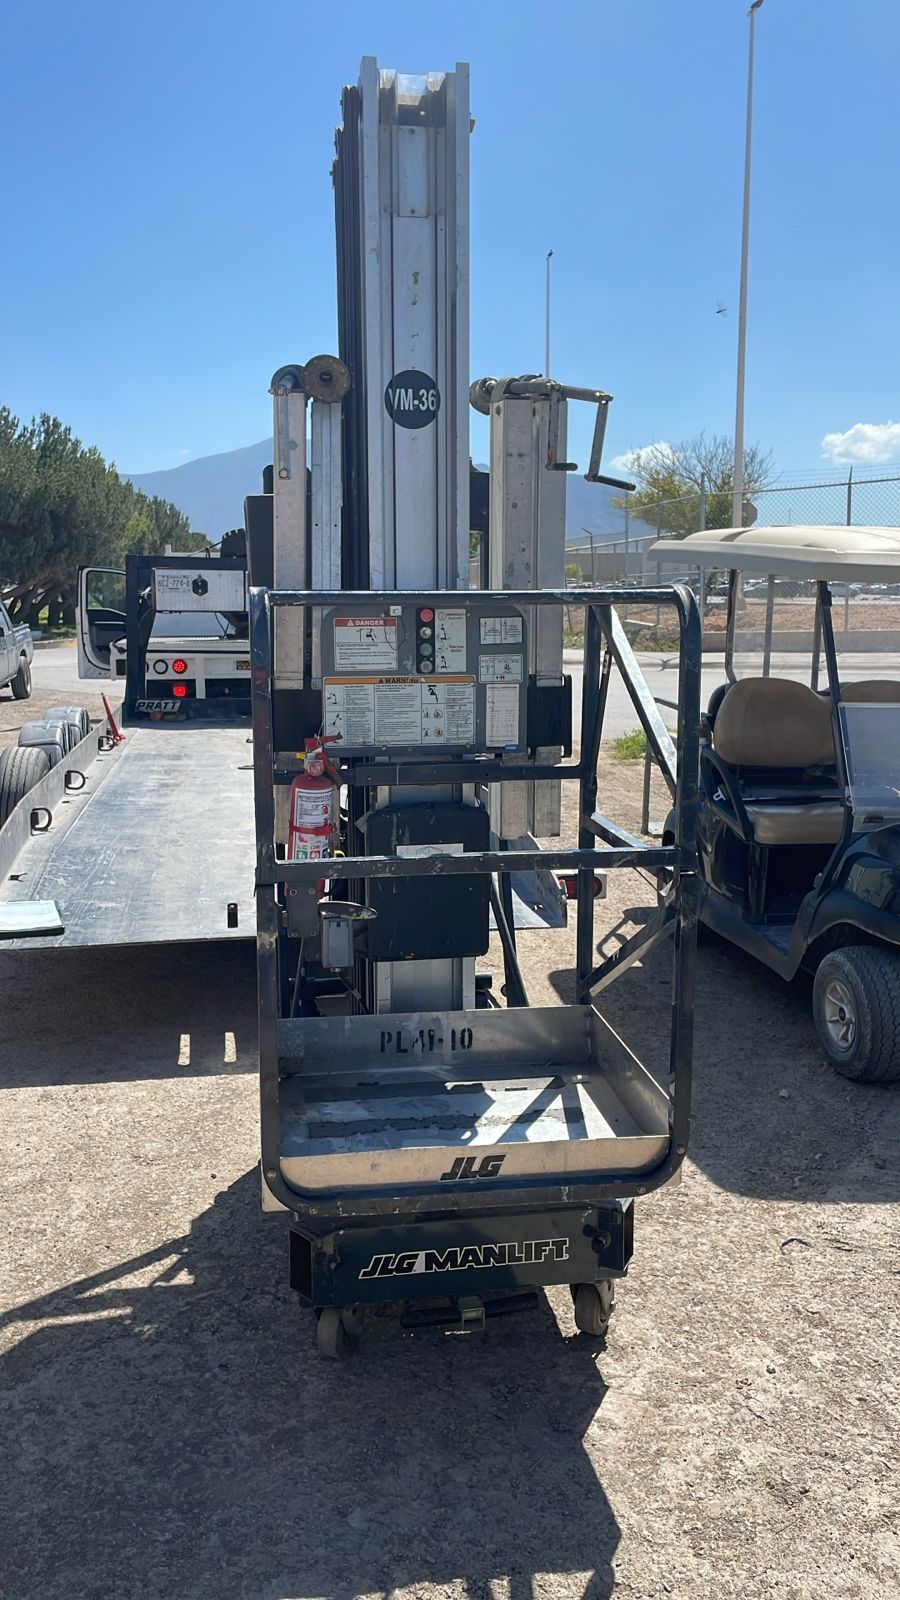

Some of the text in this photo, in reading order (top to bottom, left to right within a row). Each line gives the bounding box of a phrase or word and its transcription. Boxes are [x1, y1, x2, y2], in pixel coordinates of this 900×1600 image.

[388, 388, 436, 411] VM-36
[137, 700, 179, 711] PRATT
[439, 1154, 506, 1181] JLG
[358, 1238, 569, 1279] JLG MANLIFT
